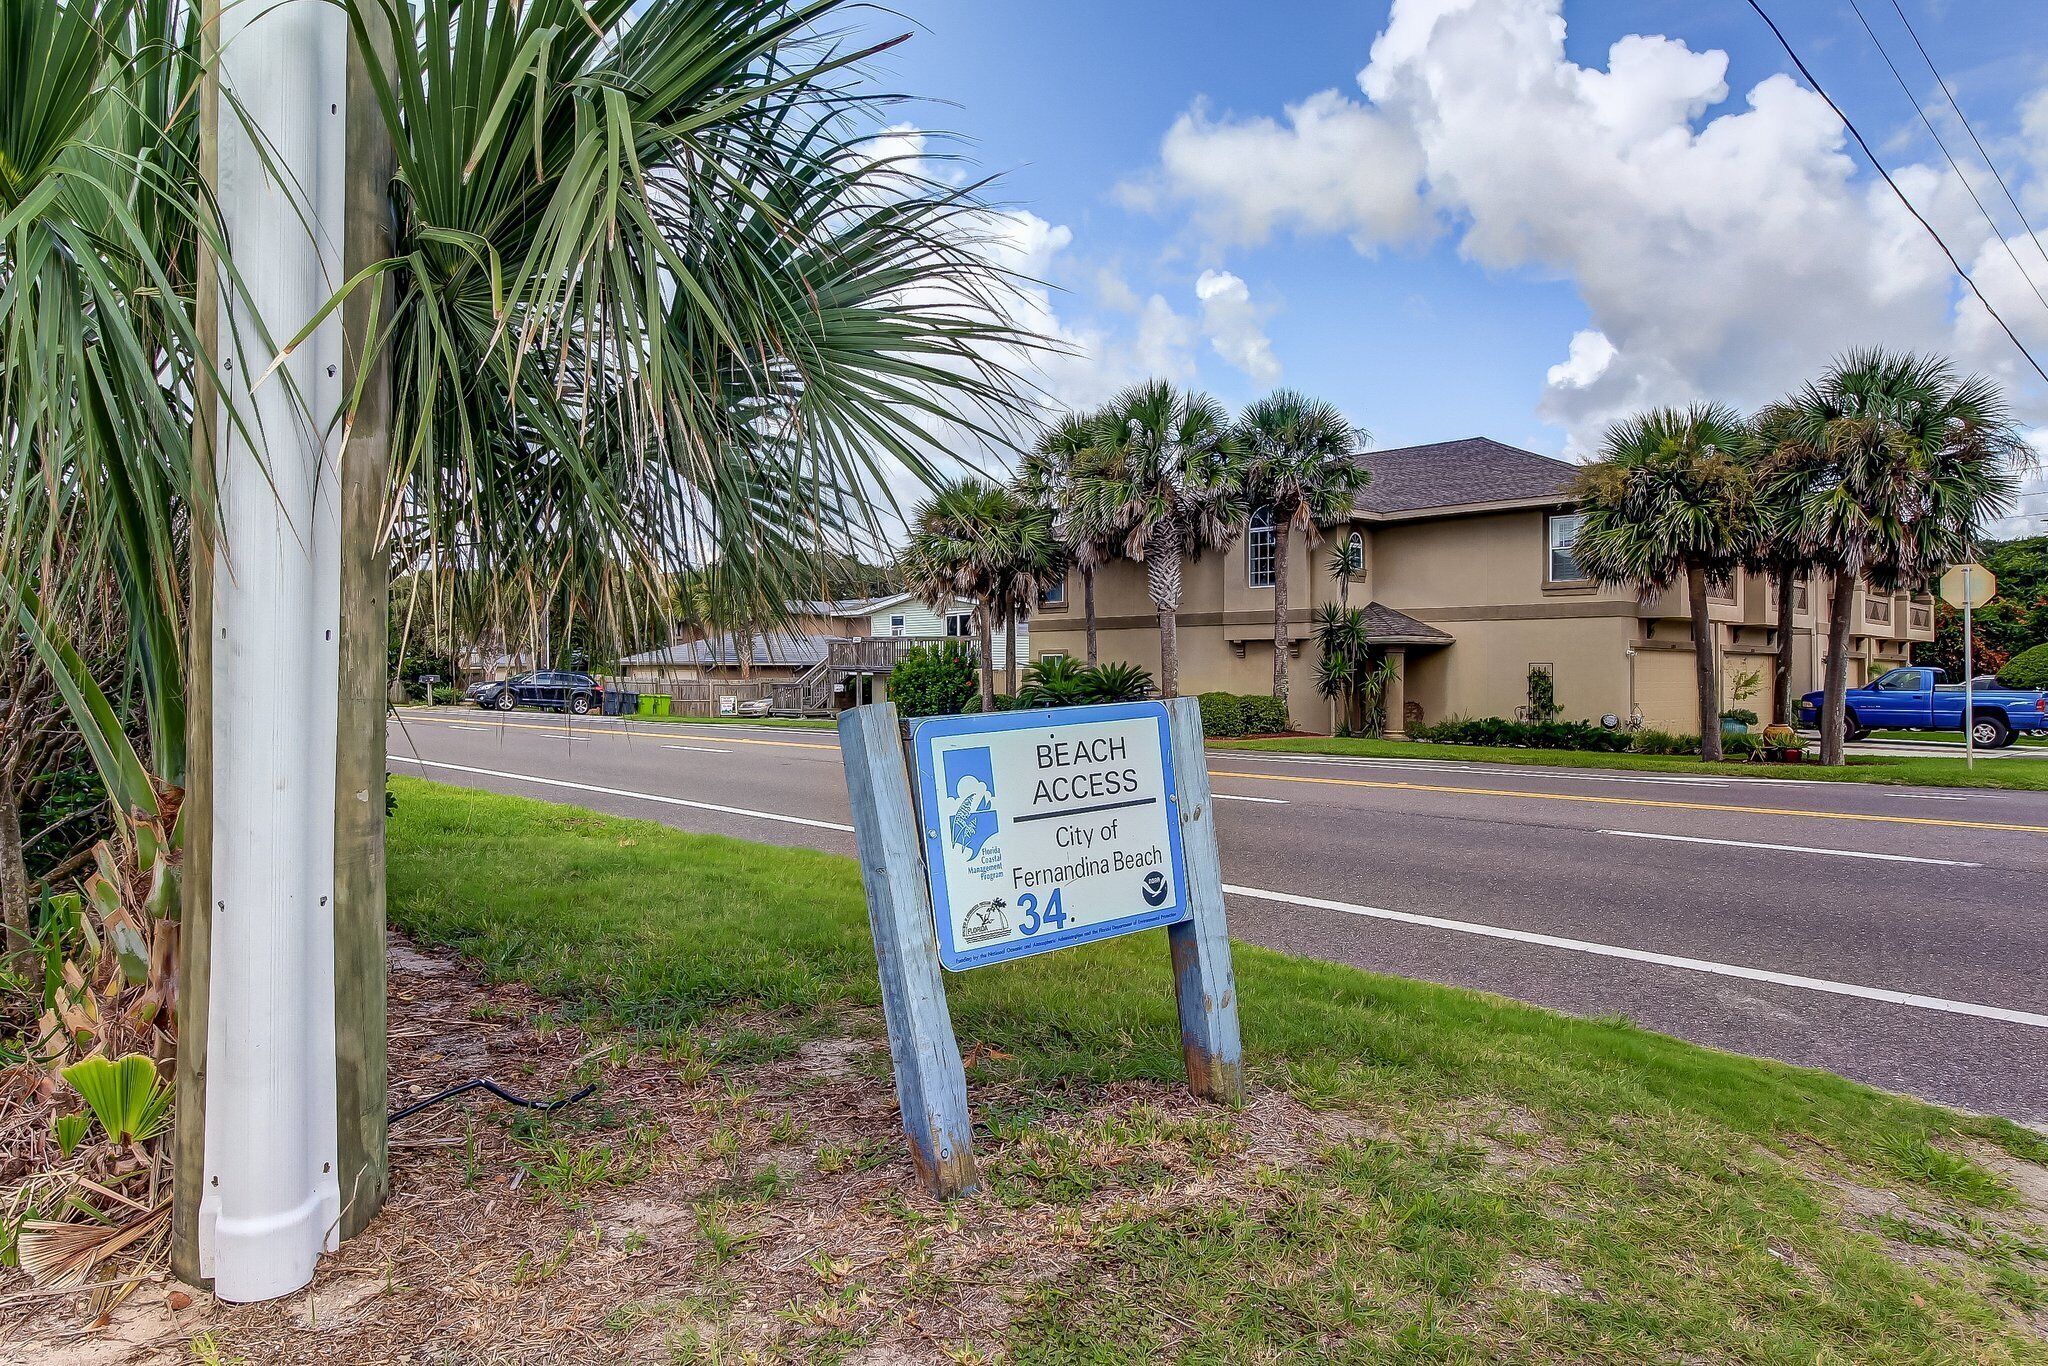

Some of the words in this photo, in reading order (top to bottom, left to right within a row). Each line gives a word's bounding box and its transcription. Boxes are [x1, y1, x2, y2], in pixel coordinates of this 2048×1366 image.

[1037, 737, 1126, 769] BEACH
[1033, 769, 1138, 805] ACCESS
[1056, 825, 1094, 848] City
[1101, 819, 1118, 841] of
[981, 854, 1002, 865] Coastal
[982, 846, 1001, 856] Florida
[968, 862, 1003, 875] Management
[981, 872, 1004, 882] Program
[1012, 856, 1110, 889] Fernandina
[1113, 845, 1163, 871] Beach
[1017, 888, 1067, 935] 34
[967, 925, 989, 935] FLORIDA
